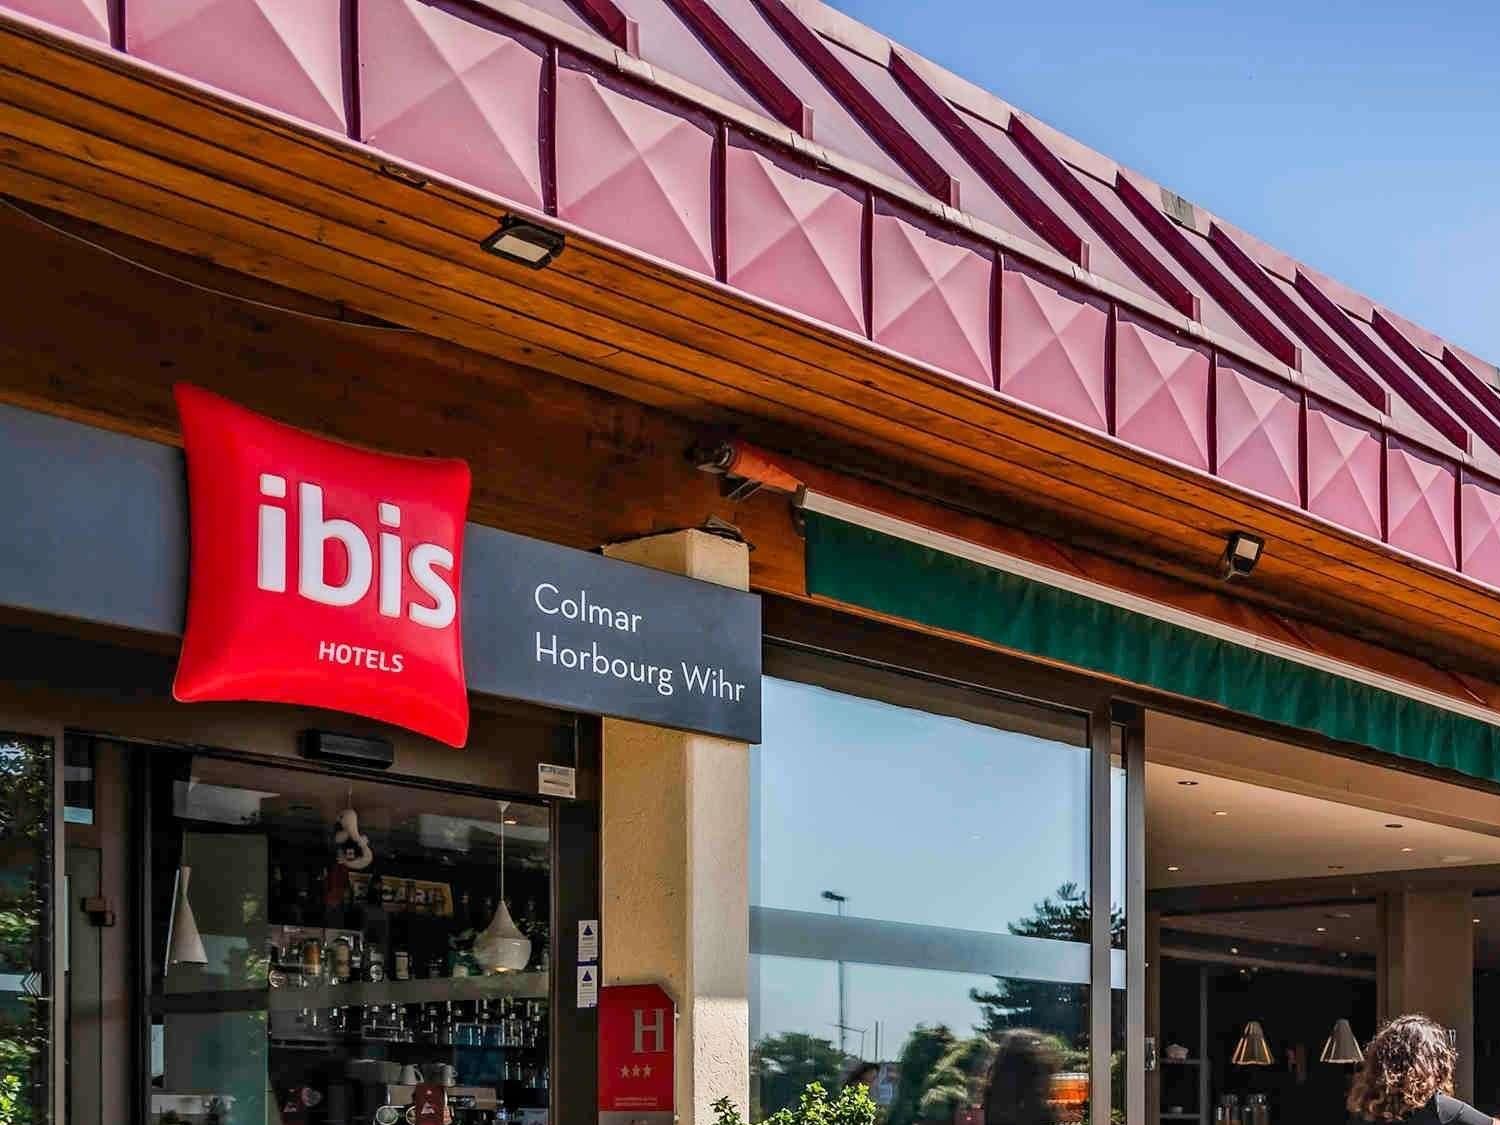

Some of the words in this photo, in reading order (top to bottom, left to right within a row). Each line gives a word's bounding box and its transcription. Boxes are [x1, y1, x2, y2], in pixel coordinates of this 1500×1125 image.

[257, 473, 457, 629] ibis
[534, 583, 642, 633] Colmar
[318, 640, 404, 673] HOTELS
[535, 631, 674, 696] Horbourg
[681, 662, 746, 702] Wihr
[632, 1007, 665, 1054] H
